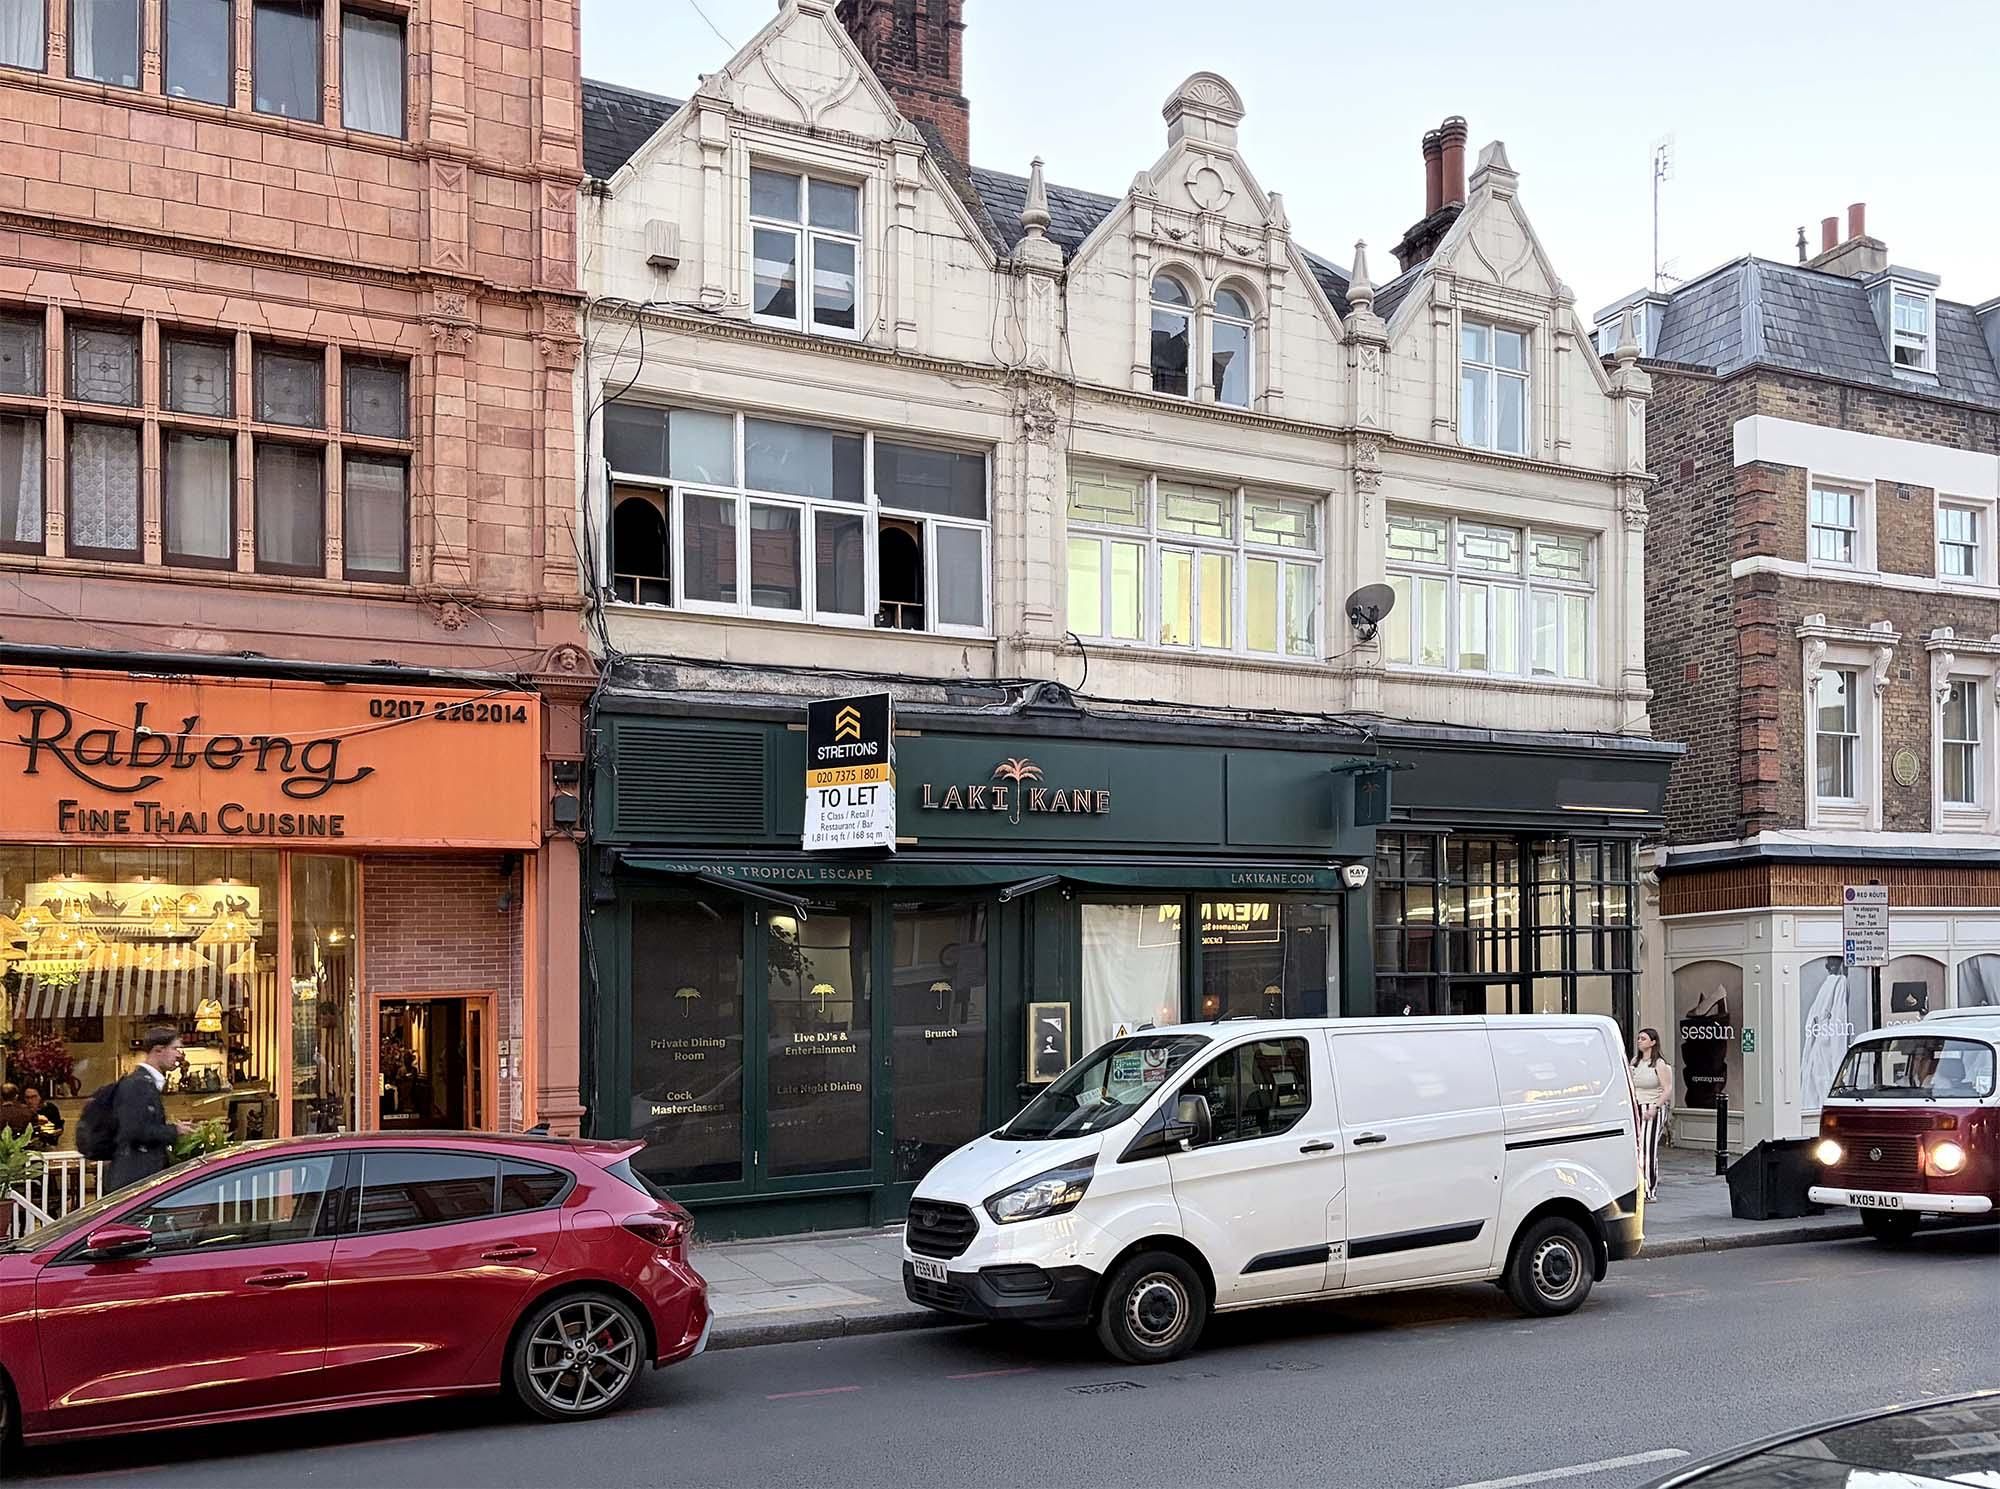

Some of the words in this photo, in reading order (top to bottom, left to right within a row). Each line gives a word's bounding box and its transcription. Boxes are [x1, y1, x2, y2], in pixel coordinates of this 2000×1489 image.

[370, 699, 425, 718] 0207
[434, 702, 528, 723] 2262014
[1, 695, 376, 800] Rabieng
[817, 741, 878, 760] STRETTONS
[816, 771, 833, 784] 020
[835, 769, 856, 783] 7375
[860, 767, 879, 780] 1801
[819, 788, 841, 808] TO
[848, 785, 879, 806] LET
[922, 784, 1009, 810] LAKI
[1029, 787, 1110, 814] KANE
[58, 799, 131, 832] FINE
[134, 801, 208, 834] THAI
[217, 803, 345, 836] CUISINE
[821, 812, 825, 821] E
[827, 811, 844, 820] Class
[850, 809, 870, 819] Retail
[820, 822, 855, 831] Restaurant
[862, 819, 874, 829] Bar
[830, 834, 839, 843] sq
[840, 832, 846, 840] ft
[852, 830, 865, 839] 168
[866, 832, 874, 840] sq
[740, 866, 815, 879] TROPICAL
[819, 868, 873, 880] ESCAPE
[1231, 873, 1315, 884] LAKIKANE.COM
[925, 1028, 958, 1039] Brunch
[1681, 1021, 1735, 1040] sessùn
[650, 1039, 689, 1050] Private
[691, 1037, 726, 1048] Dining
[794, 1032, 815, 1043] Live
[817, 1032, 838, 1042] DJ's
[839, 1032, 848, 1041] &
[674, 1051, 705, 1061] Room
[785, 1044, 857, 1056] Entertainment
[830, 1081, 863, 1092] Dining
[1850, 1194, 1875, 1206] WX09
